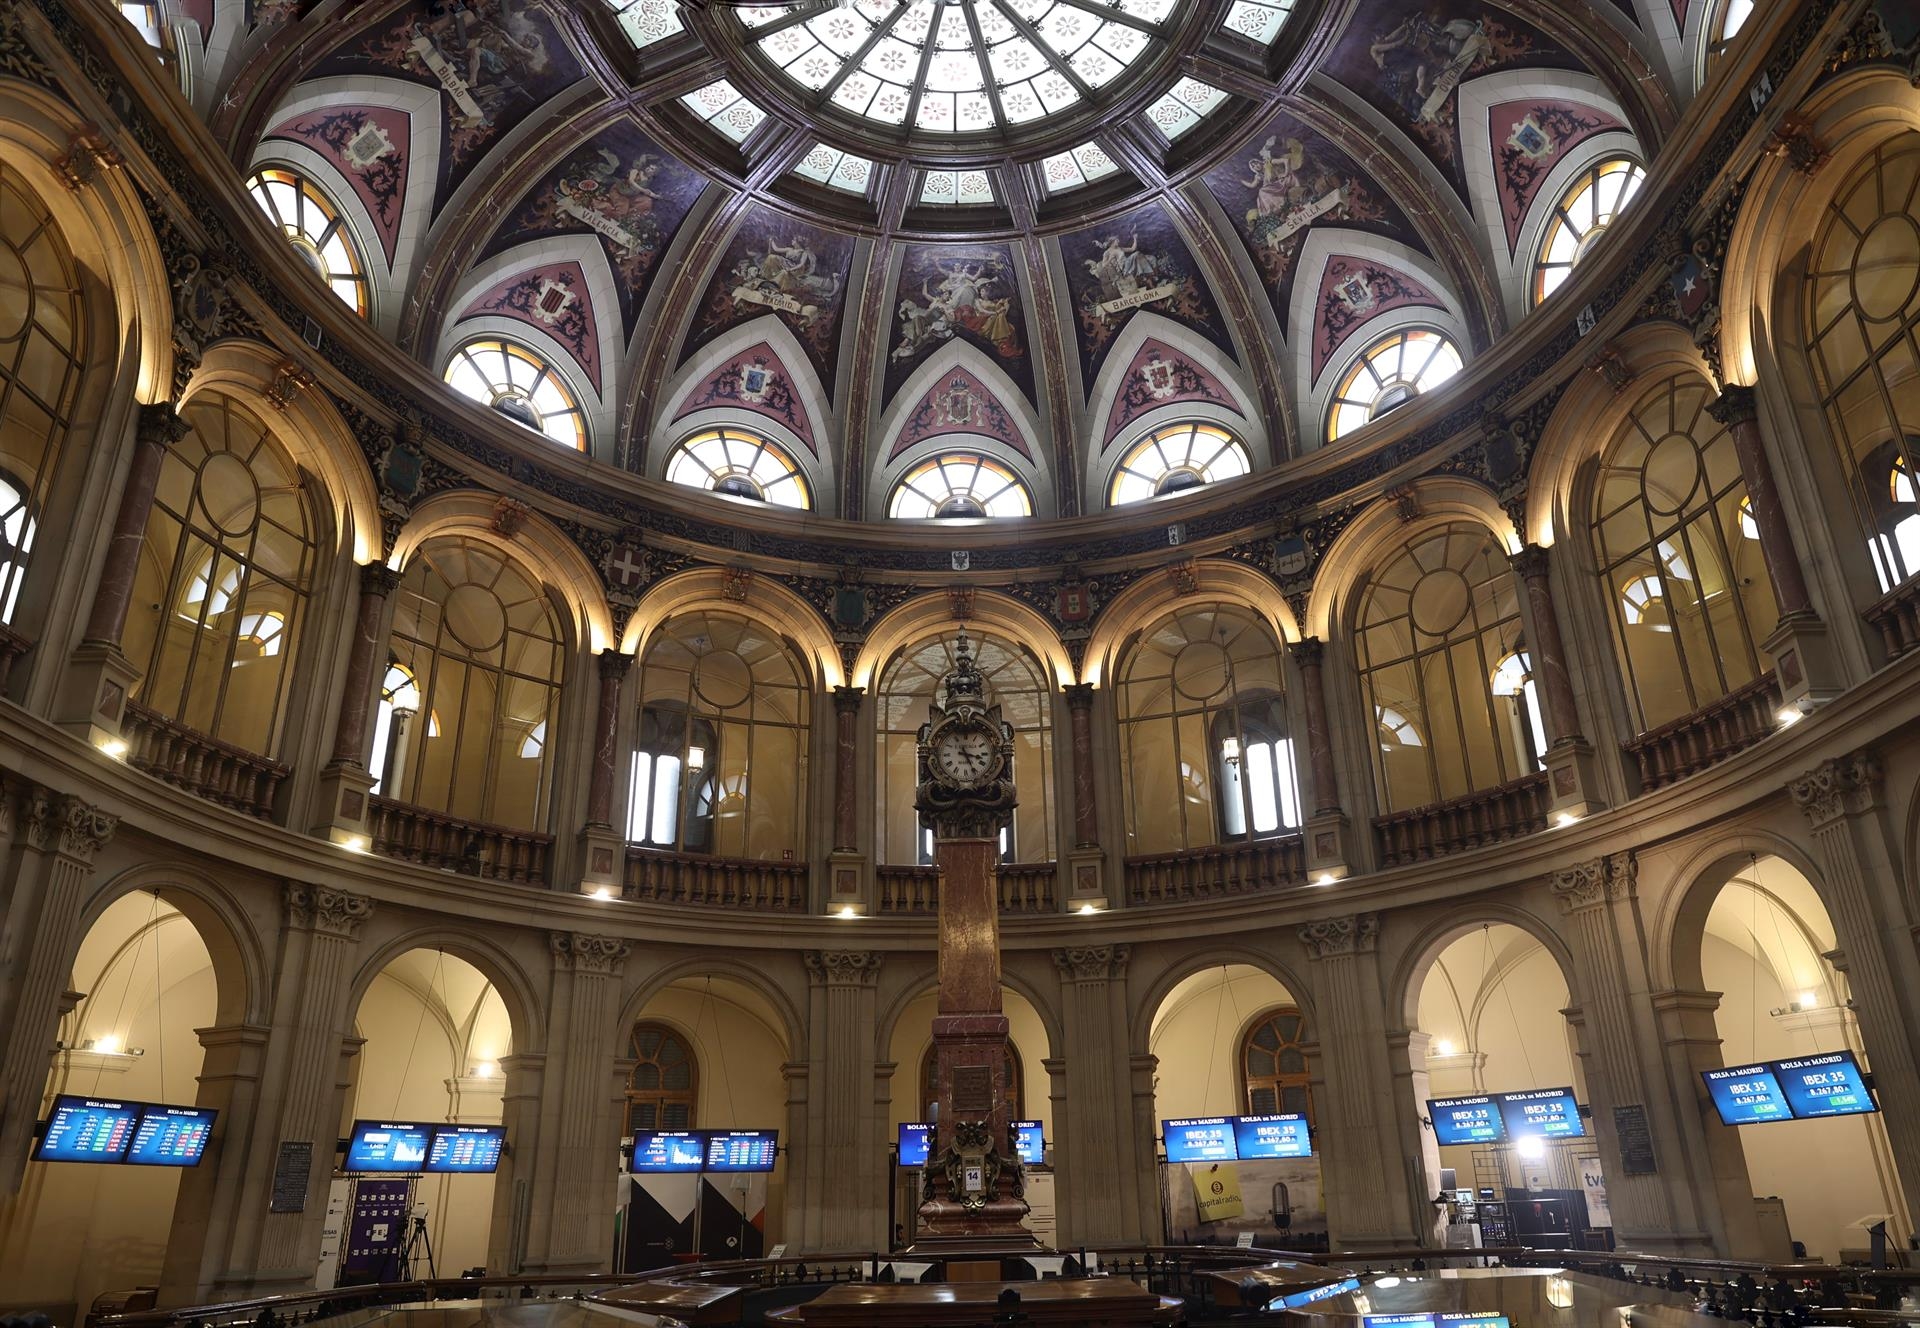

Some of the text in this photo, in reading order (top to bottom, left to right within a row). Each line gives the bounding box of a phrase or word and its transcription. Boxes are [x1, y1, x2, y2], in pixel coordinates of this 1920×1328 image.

[1781, 1062, 1803, 1070] BOLSA
[1812, 1055, 1842, 1066] MADRID
[1710, 1071, 1730, 1080] BOLSA
[1736, 1067, 1764, 1076] MADRID
[1803, 1072, 1846, 1086] IBEX 35
[1730, 1082, 1767, 1095] IBEX 35
[1535, 1090, 1563, 1099] MADRID
[1524, 1103, 1563, 1114] IBEX 35
[1452, 1110, 1488, 1120] IBEX 35
[1185, 1131, 1208, 1139] IBEX
[1257, 1126, 1295, 1136] IBEX 35
